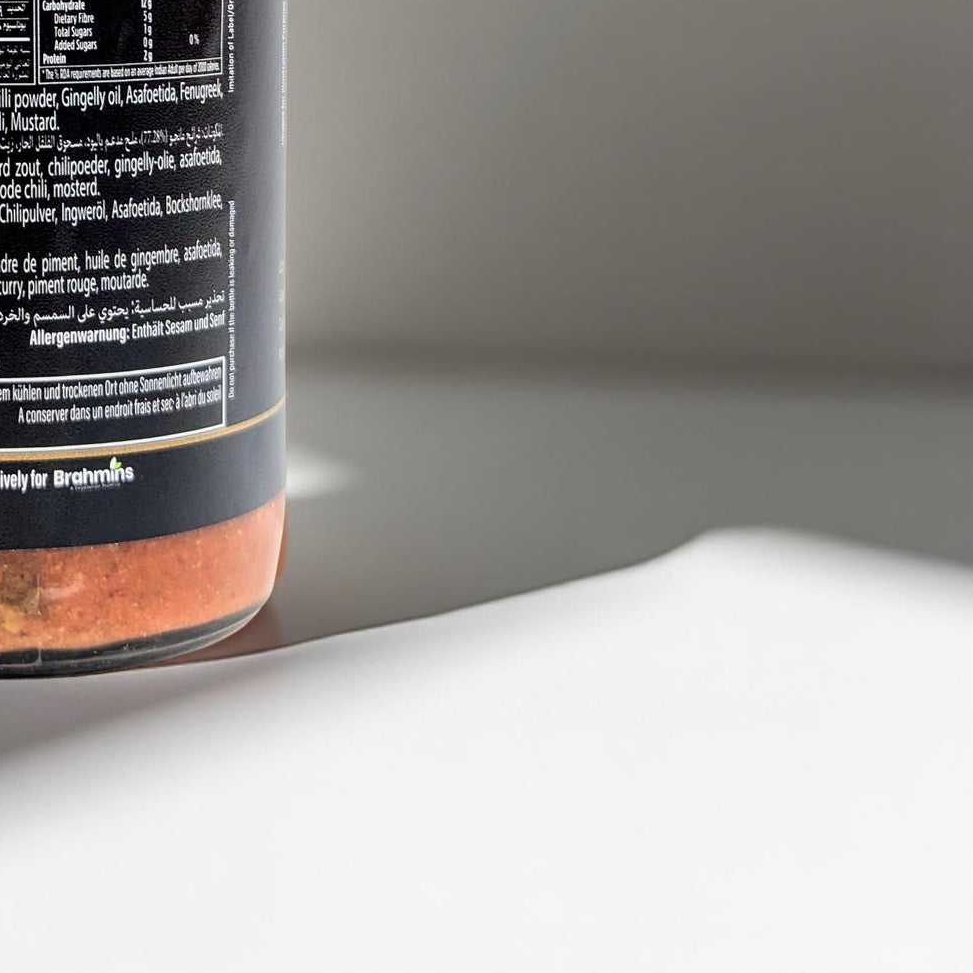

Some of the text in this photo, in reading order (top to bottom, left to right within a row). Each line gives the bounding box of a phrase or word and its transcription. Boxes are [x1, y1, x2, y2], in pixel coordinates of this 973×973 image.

[42, 0, 85, 13] Carbohydrate
[54, 13, 95, 25] Dietary Fibre
[54, 39, 97, 52] Added Sugars
[228, 41, 236, 50] of
[228, 53, 236, 93] Imitation
[14, 87, 59, 113] powder,
[61, 87, 105, 111] Gingelly
[108, 86, 123, 108] oil,
[126, 81, 178, 105] Asafoetida,
[179, 78, 224, 105] Fenugreek,
[11, 111, 60, 132] Mustard.
[15, 159, 43, 181] zout,
[47, 154, 111, 181] chilipoeder,
[114, 151, 177, 178] gingelly-olie,
[179, 145, 223, 169] asafoetida,
[0, 201, 59, 225] Chilipulver,
[61, 199, 109, 227] Ingweröl,
[111, 197, 163, 219] Asafoetida,
[165, 190, 223, 215] Bockshornklee,
[33, 305, 75, 326] السمسم
[77, 304, 96, 323] على
[98, 305, 129, 325] يحتوي
[29, 310, 226, 349] Allergenwarnung: Enthält Sesam und Senf
[31, 469, 48, 489] for
[53, 459, 135, 488] Brahmins
